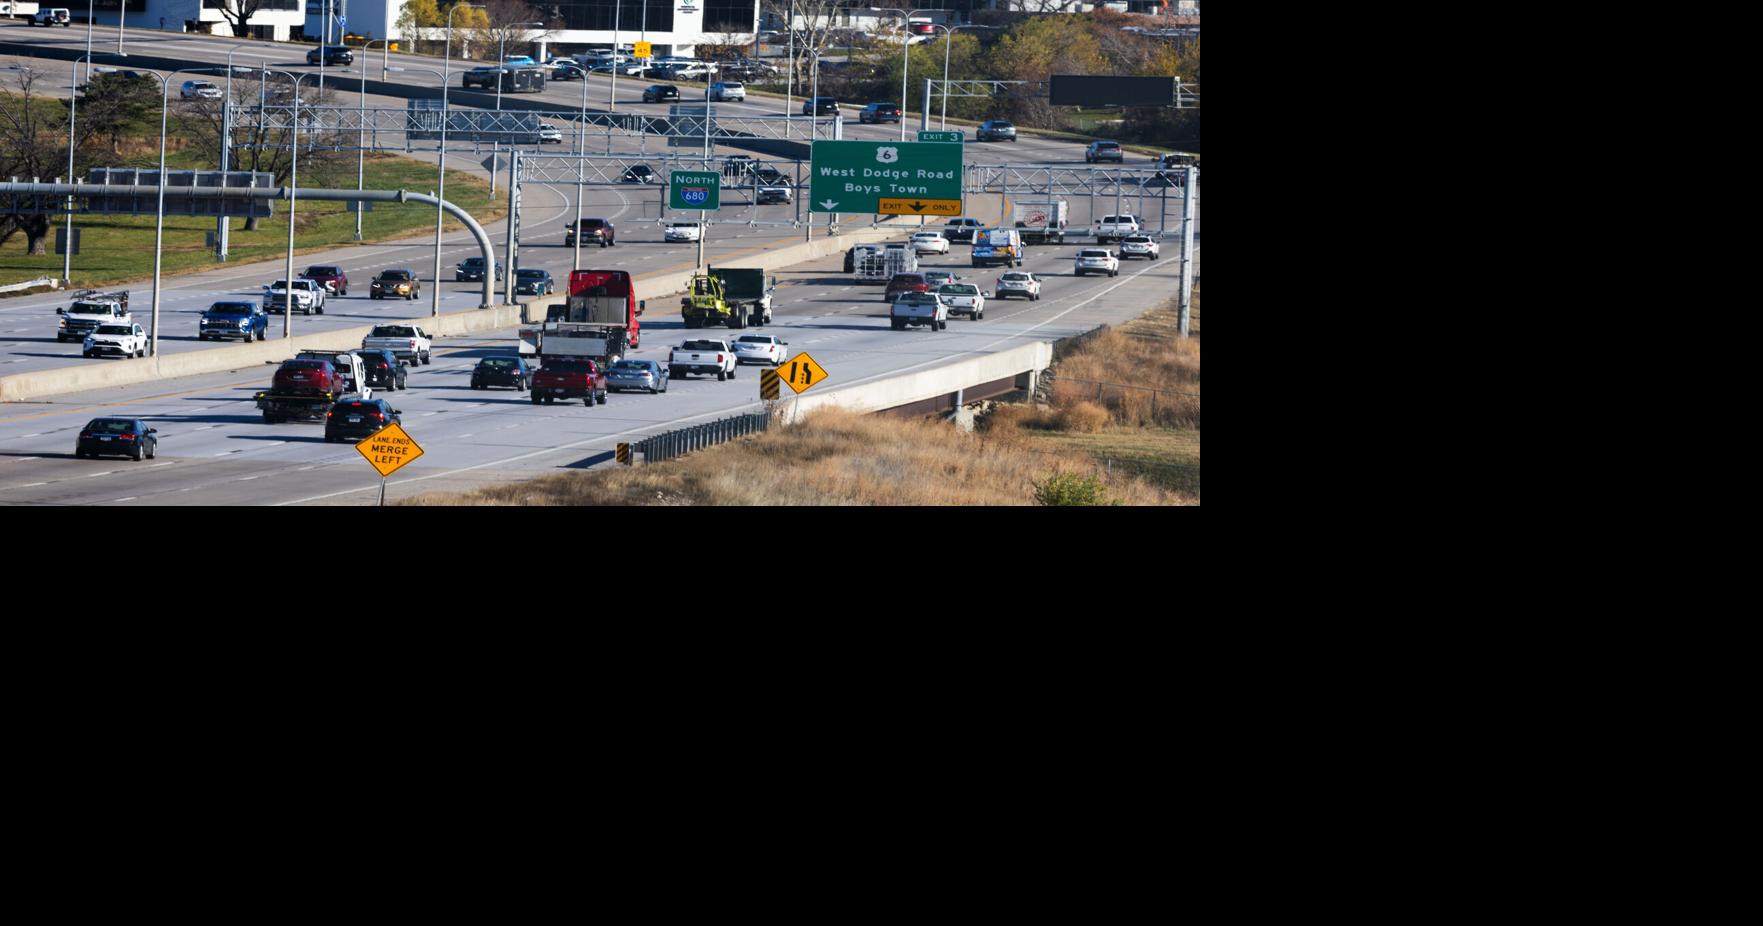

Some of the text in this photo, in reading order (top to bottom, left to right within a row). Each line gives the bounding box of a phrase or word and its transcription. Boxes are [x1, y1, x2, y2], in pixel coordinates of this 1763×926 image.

[950, 133, 958, 141] 3
[883, 150, 891, 160] 6
[820, 167, 953, 180] West Dodge Road
[845, 183, 927, 194] Boys Town
[685, 192, 704, 200] 680
[392, 437, 410, 445] ENDS
[371, 444, 408, 455] MERGE
[375, 455, 401, 464] LEFT
